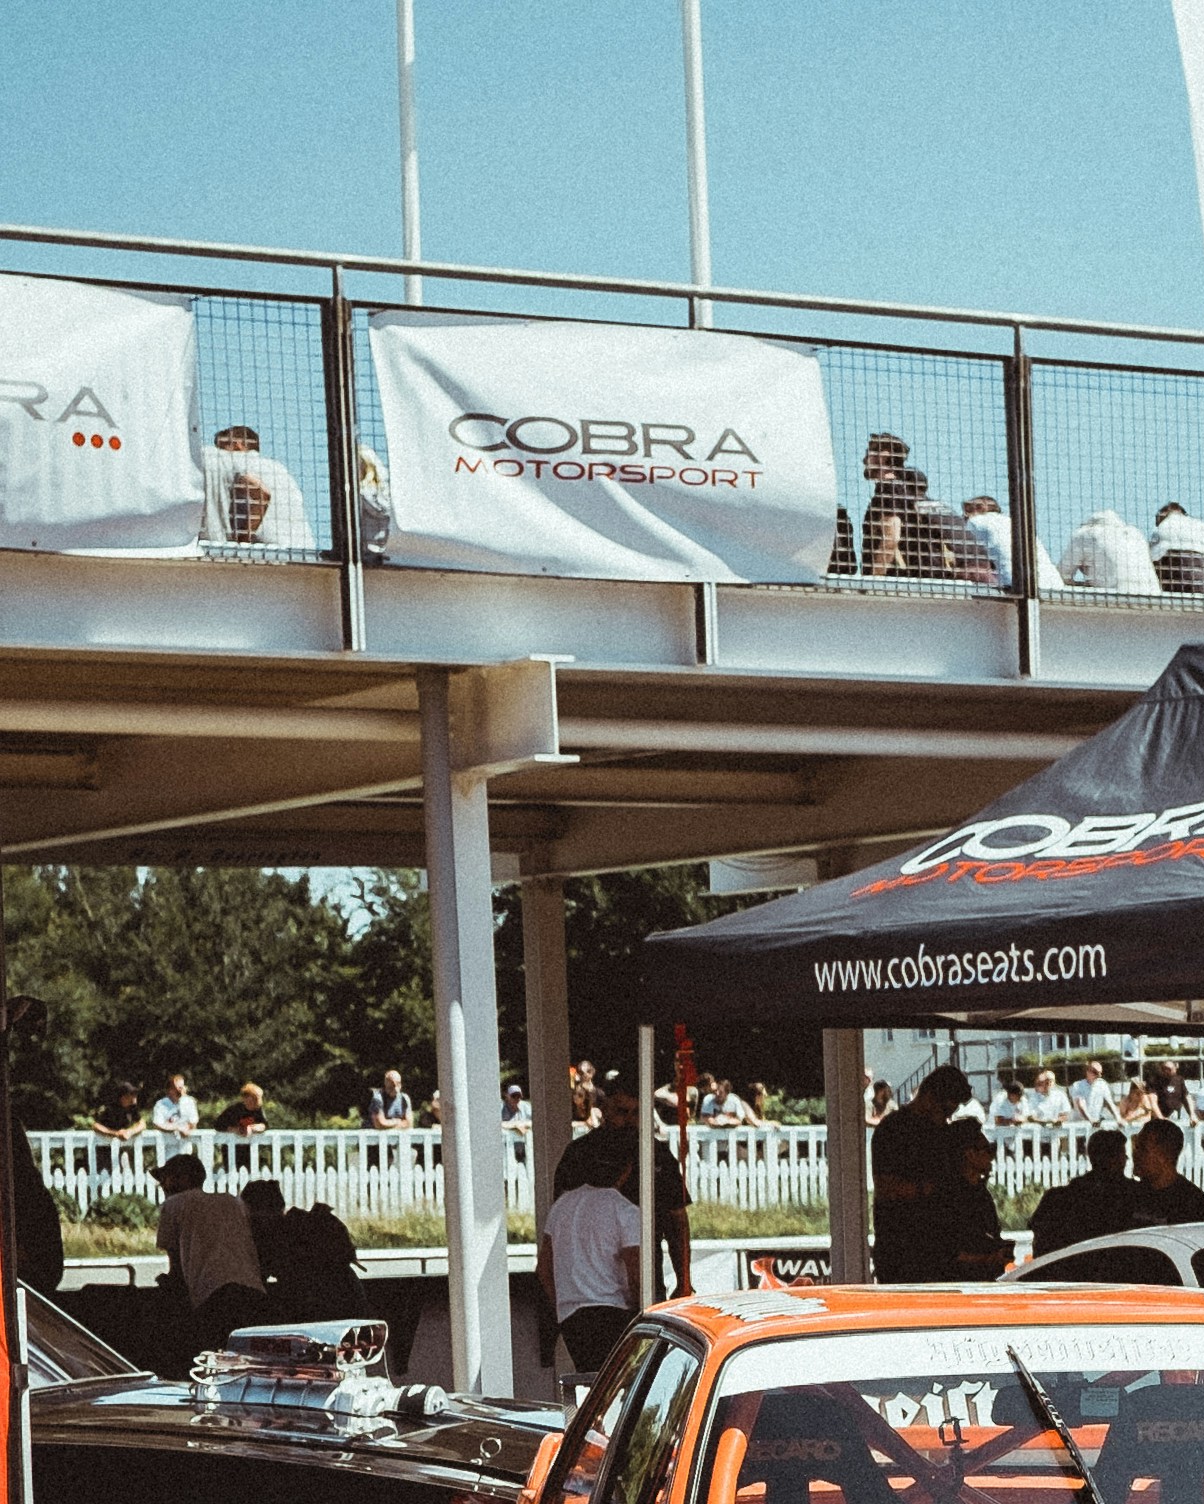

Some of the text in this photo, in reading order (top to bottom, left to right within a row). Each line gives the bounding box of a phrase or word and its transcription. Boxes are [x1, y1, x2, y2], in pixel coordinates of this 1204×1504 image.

[449, 412, 764, 464] COBRA
[454, 456, 764, 490] MOTORSPORT
[814, 942, 1107, 992] www.cobraseats.com
